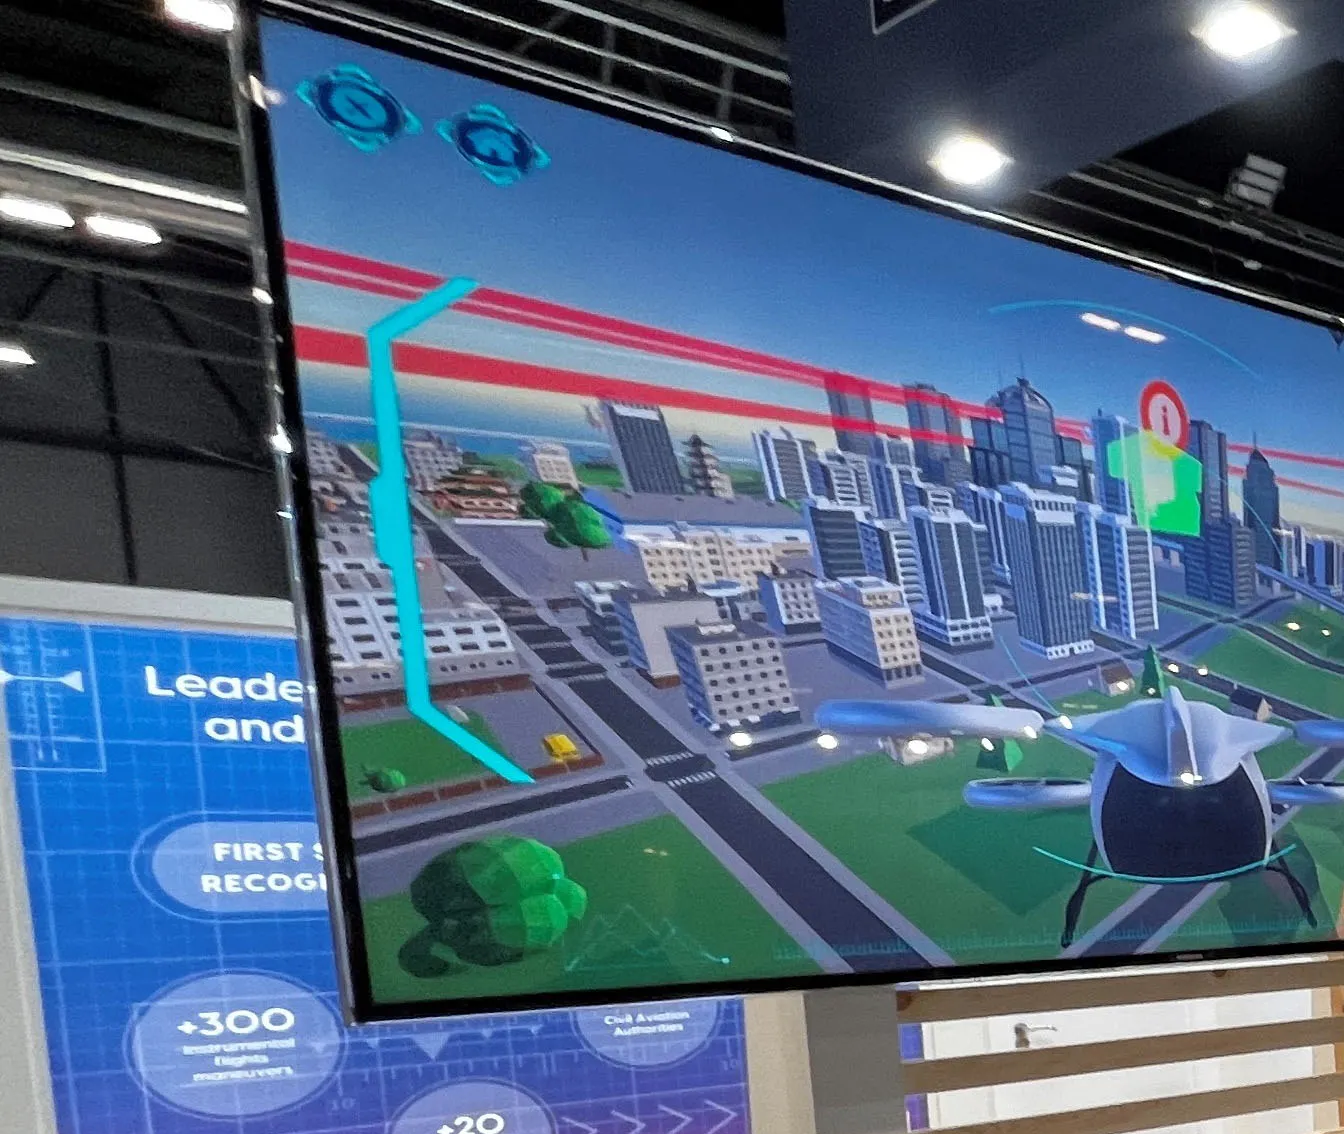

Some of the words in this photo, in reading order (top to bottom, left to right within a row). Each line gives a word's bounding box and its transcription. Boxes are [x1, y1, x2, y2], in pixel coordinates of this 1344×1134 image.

[204, 714, 305, 743] and
[213, 842, 304, 862] FIRST
[177, 1007, 295, 1036] +300
[635, 1011, 691, 1024] Aviation
[613, 1023, 684, 1037] Authorities
